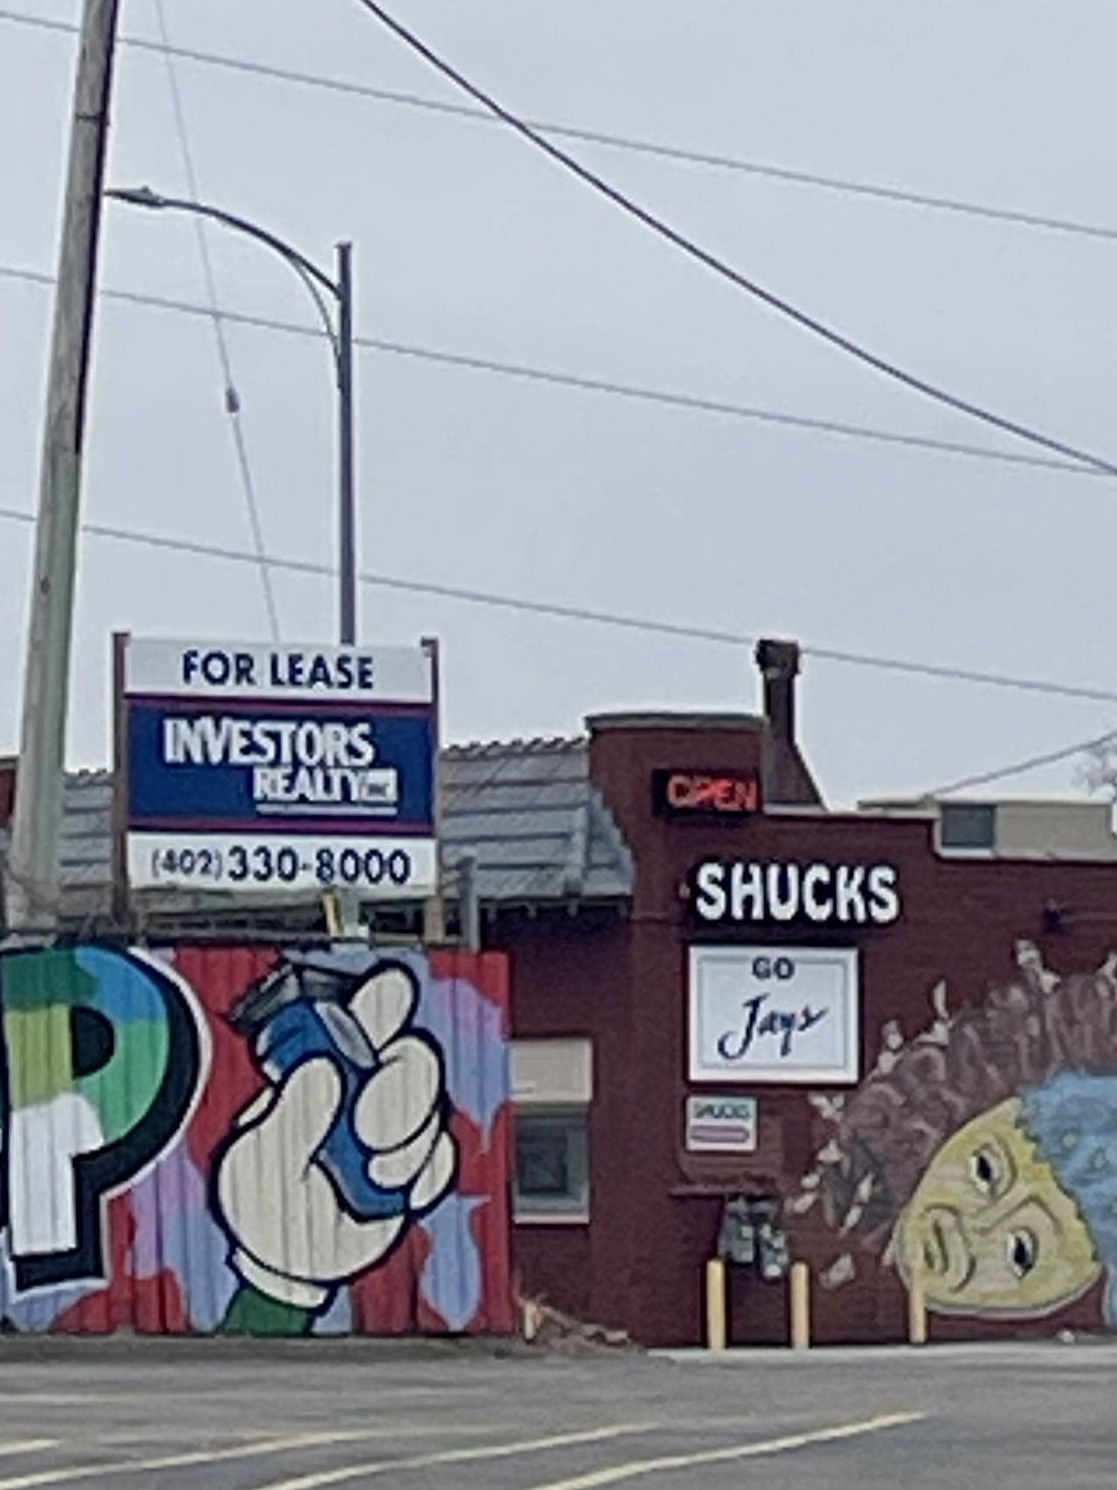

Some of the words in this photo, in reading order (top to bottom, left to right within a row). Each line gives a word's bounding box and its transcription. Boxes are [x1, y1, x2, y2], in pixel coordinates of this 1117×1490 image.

[183, 650, 256, 686] FOR
[270, 653, 374, 690] LEASE
[163, 716, 376, 767] INVESTORS
[253, 766, 364, 802] REALTY
[667, 775, 757, 811] OPEN
[152, 848, 222, 882] (402)
[228, 845, 412, 886] 330-8000
[695, 861, 901, 923] SHUCKS
[752, 956, 795, 981] GO
[717, 993, 829, 1060] Jays
